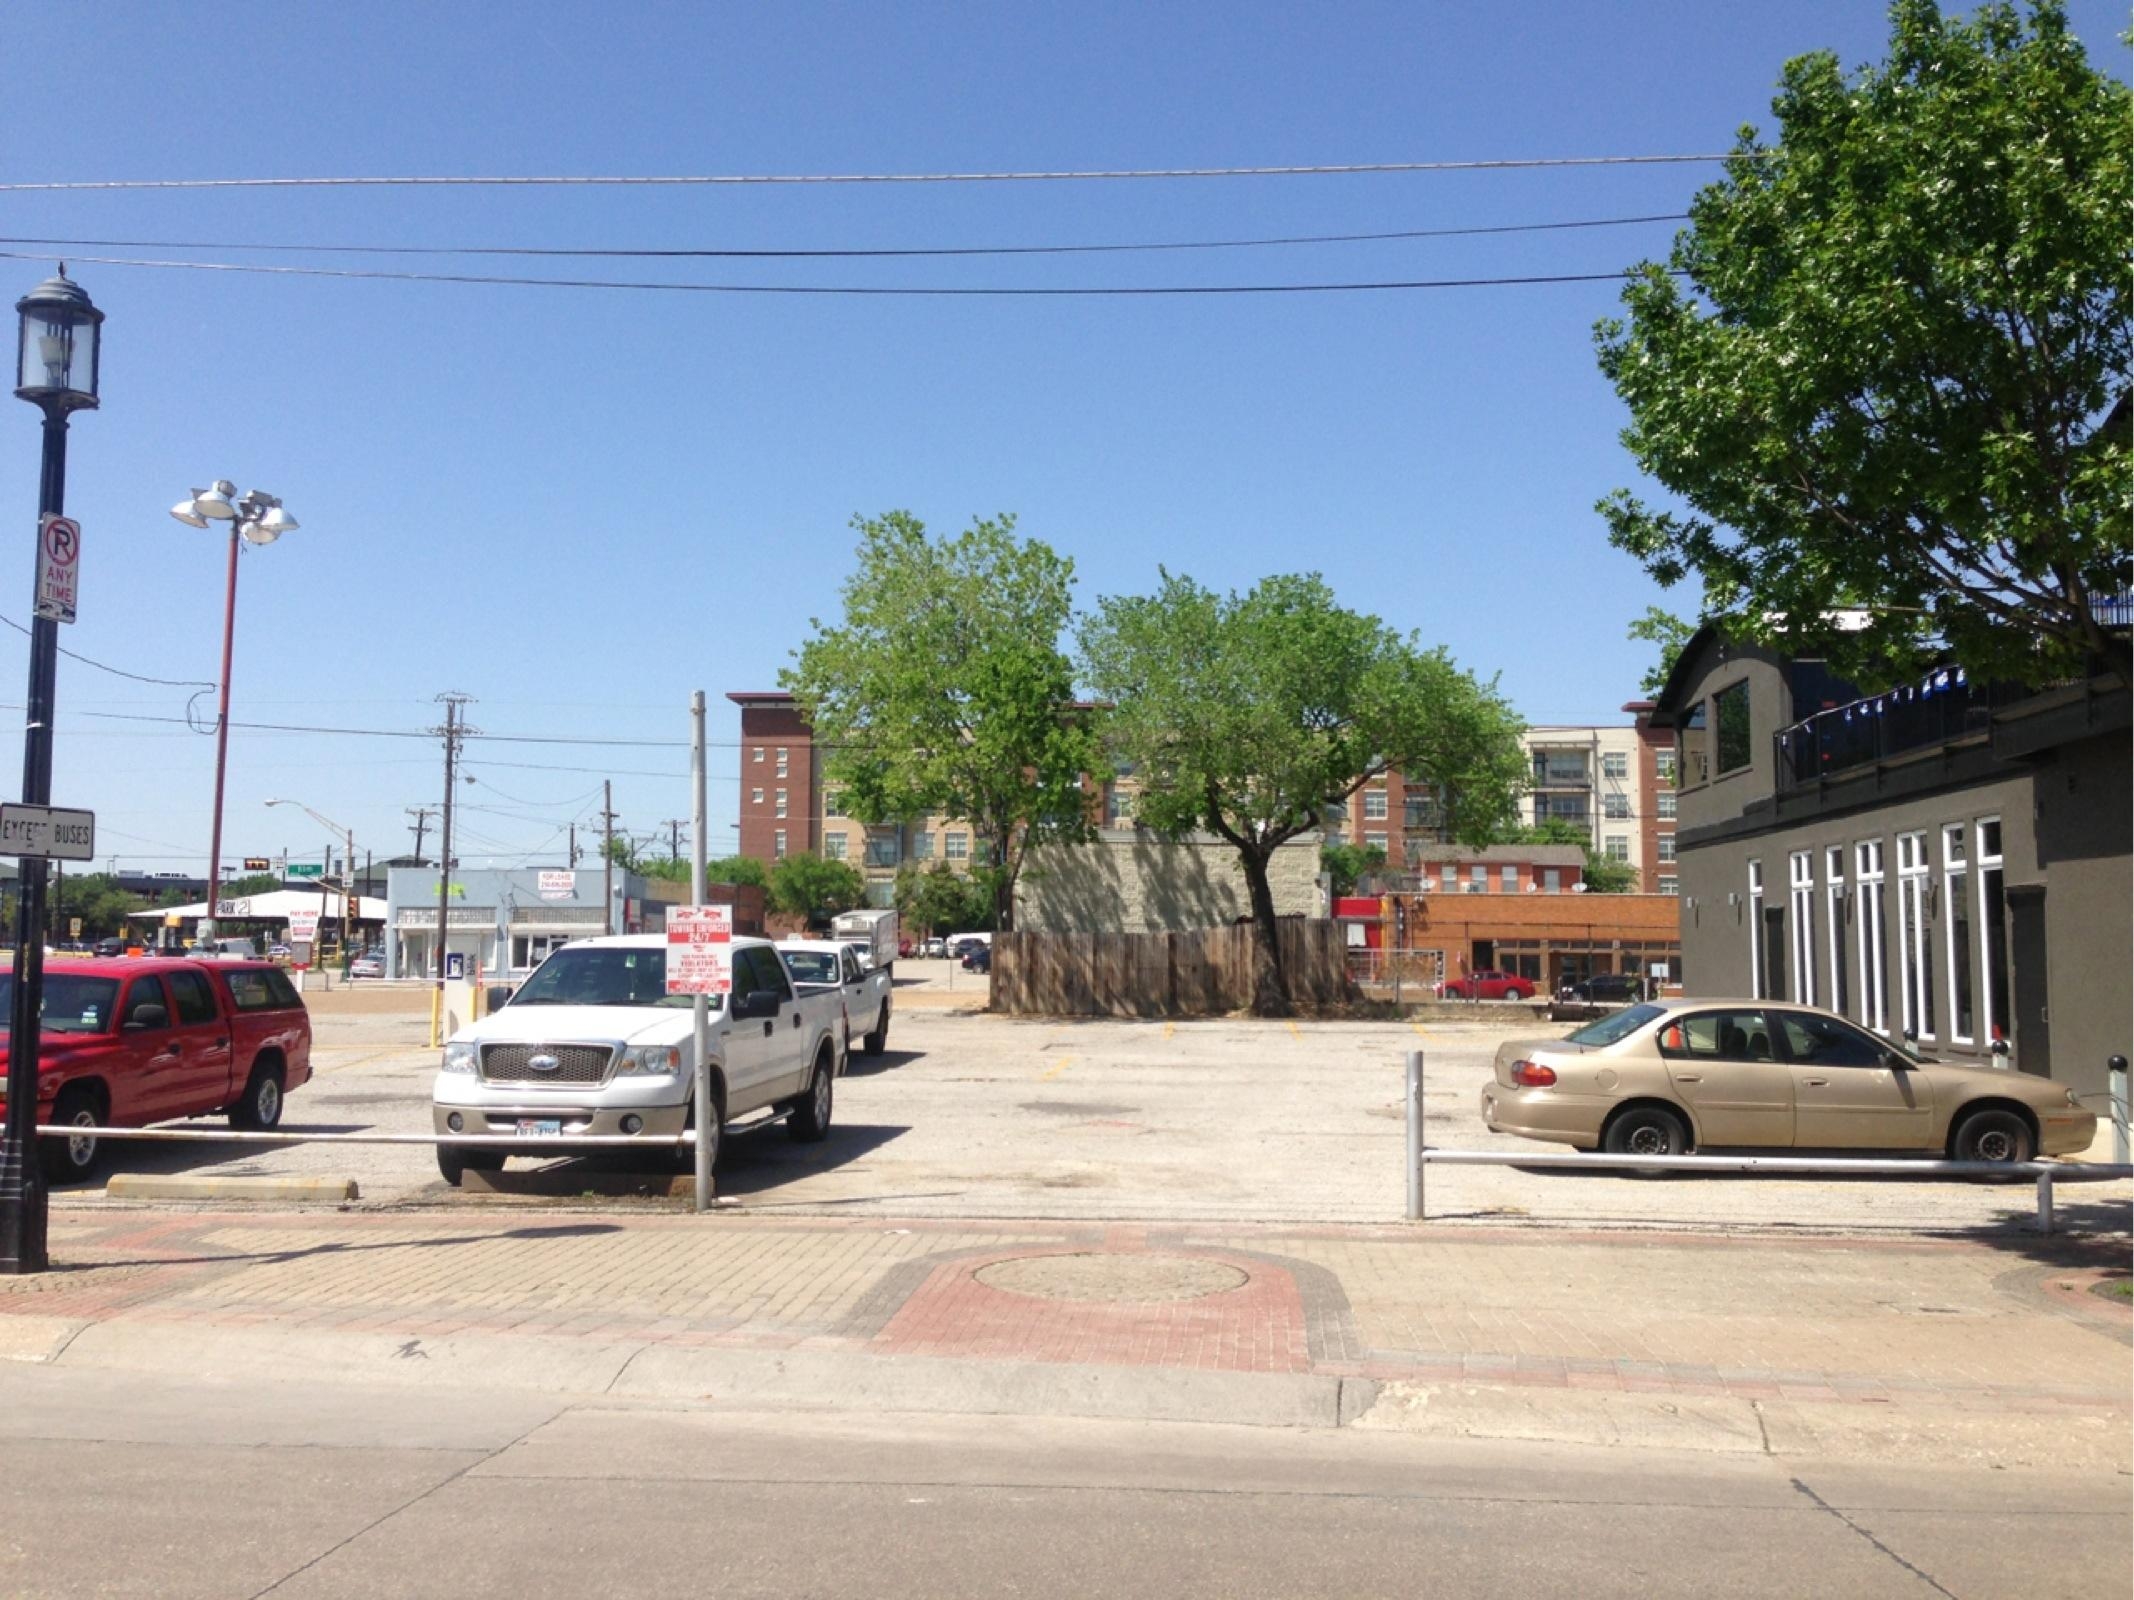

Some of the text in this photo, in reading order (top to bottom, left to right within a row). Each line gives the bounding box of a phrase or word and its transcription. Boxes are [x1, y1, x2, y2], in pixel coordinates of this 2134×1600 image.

[46, 566, 73, 583] ANY
[45, 583, 73, 603] TIME
[54, 823, 89, 845] BUSES
